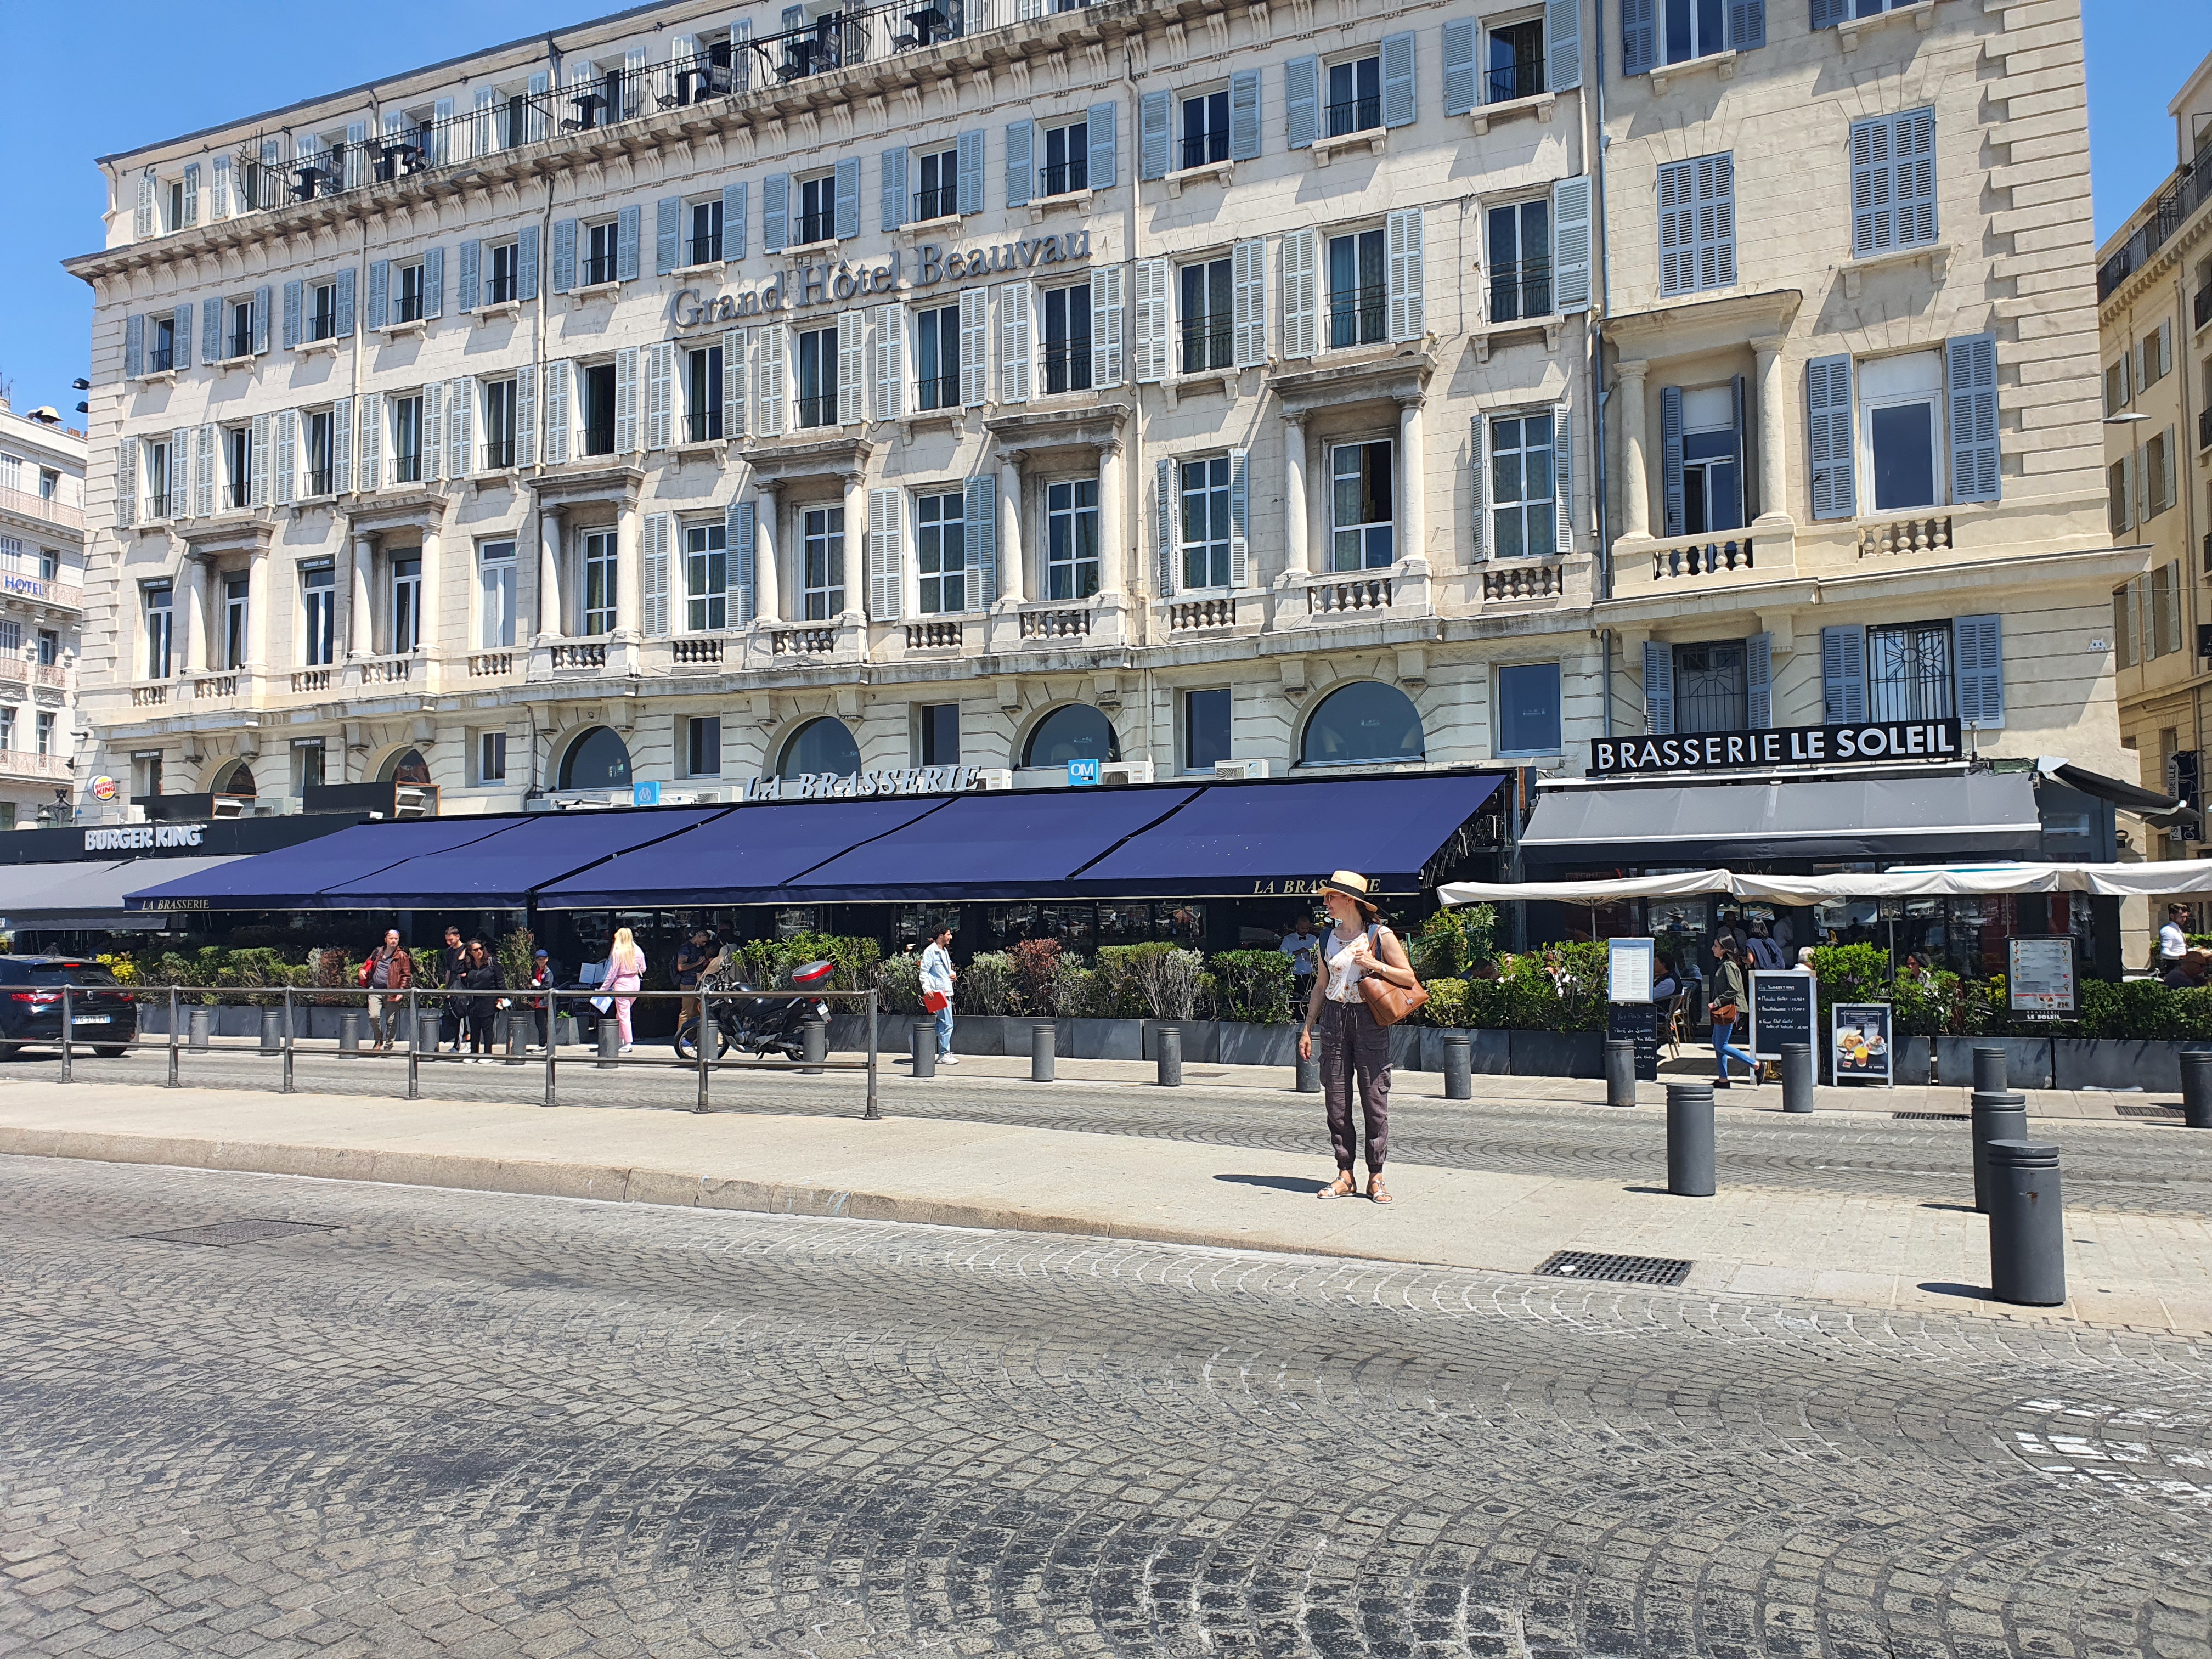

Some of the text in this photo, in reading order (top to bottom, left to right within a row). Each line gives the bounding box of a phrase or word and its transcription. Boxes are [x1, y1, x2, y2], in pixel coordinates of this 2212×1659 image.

[669, 229, 1094, 328] Grand Hôtel Beauvau
[5, 575, 45, 596] HOTEL
[1598, 725, 1955, 769] BRASSERIE LE SOLEIL
[1070, 763, 1094, 776] OM
[95, 781, 114, 789] BURGER
[96, 785, 115, 797] KING
[743, 765, 981, 800] LA BRASSERIE
[85, 825, 204, 851] BURGER KING
[1253, 879, 1381, 894] LA BRASE
[142, 899, 210, 910] LA BRASSERIE
